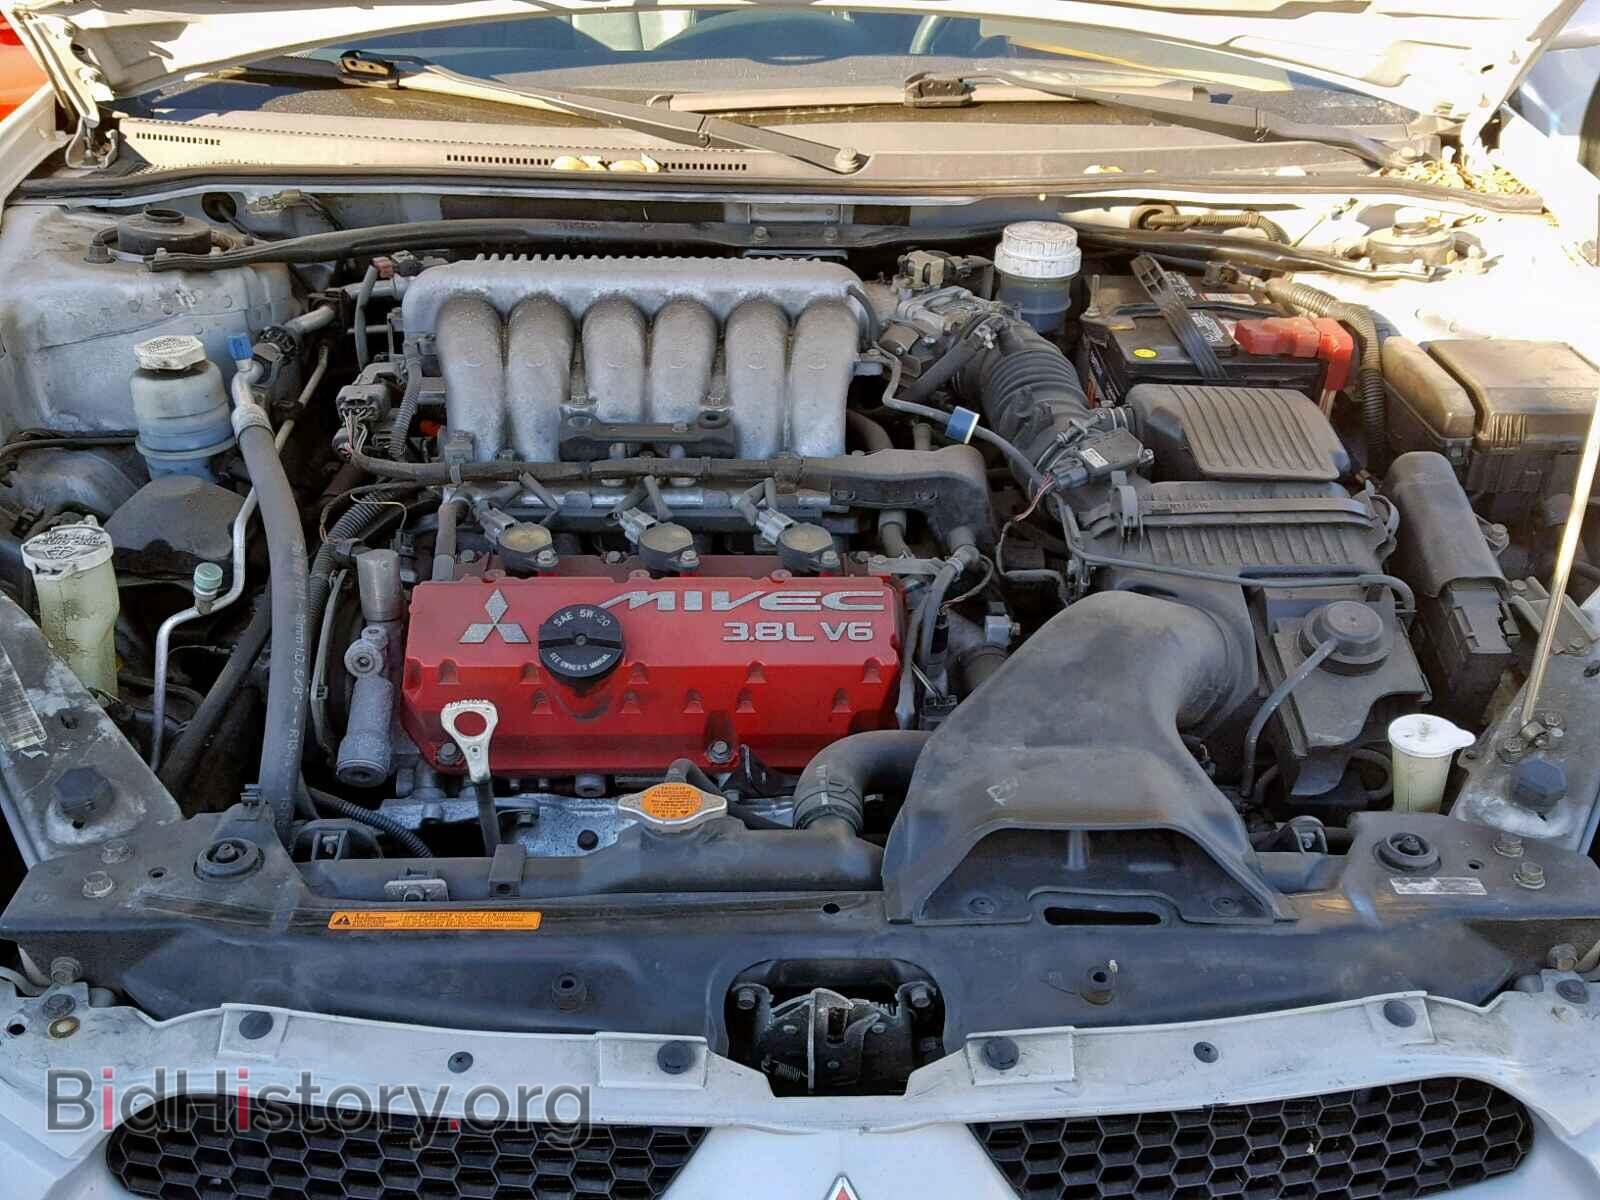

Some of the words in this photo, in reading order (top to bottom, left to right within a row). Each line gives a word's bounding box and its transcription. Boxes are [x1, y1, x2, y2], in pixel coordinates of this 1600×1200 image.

[599, 591, 885, 611] MIVEC
[553, 611, 574, 627] SAE
[723, 622, 815, 641] 3.8L
[820, 622, 873, 641] V6
